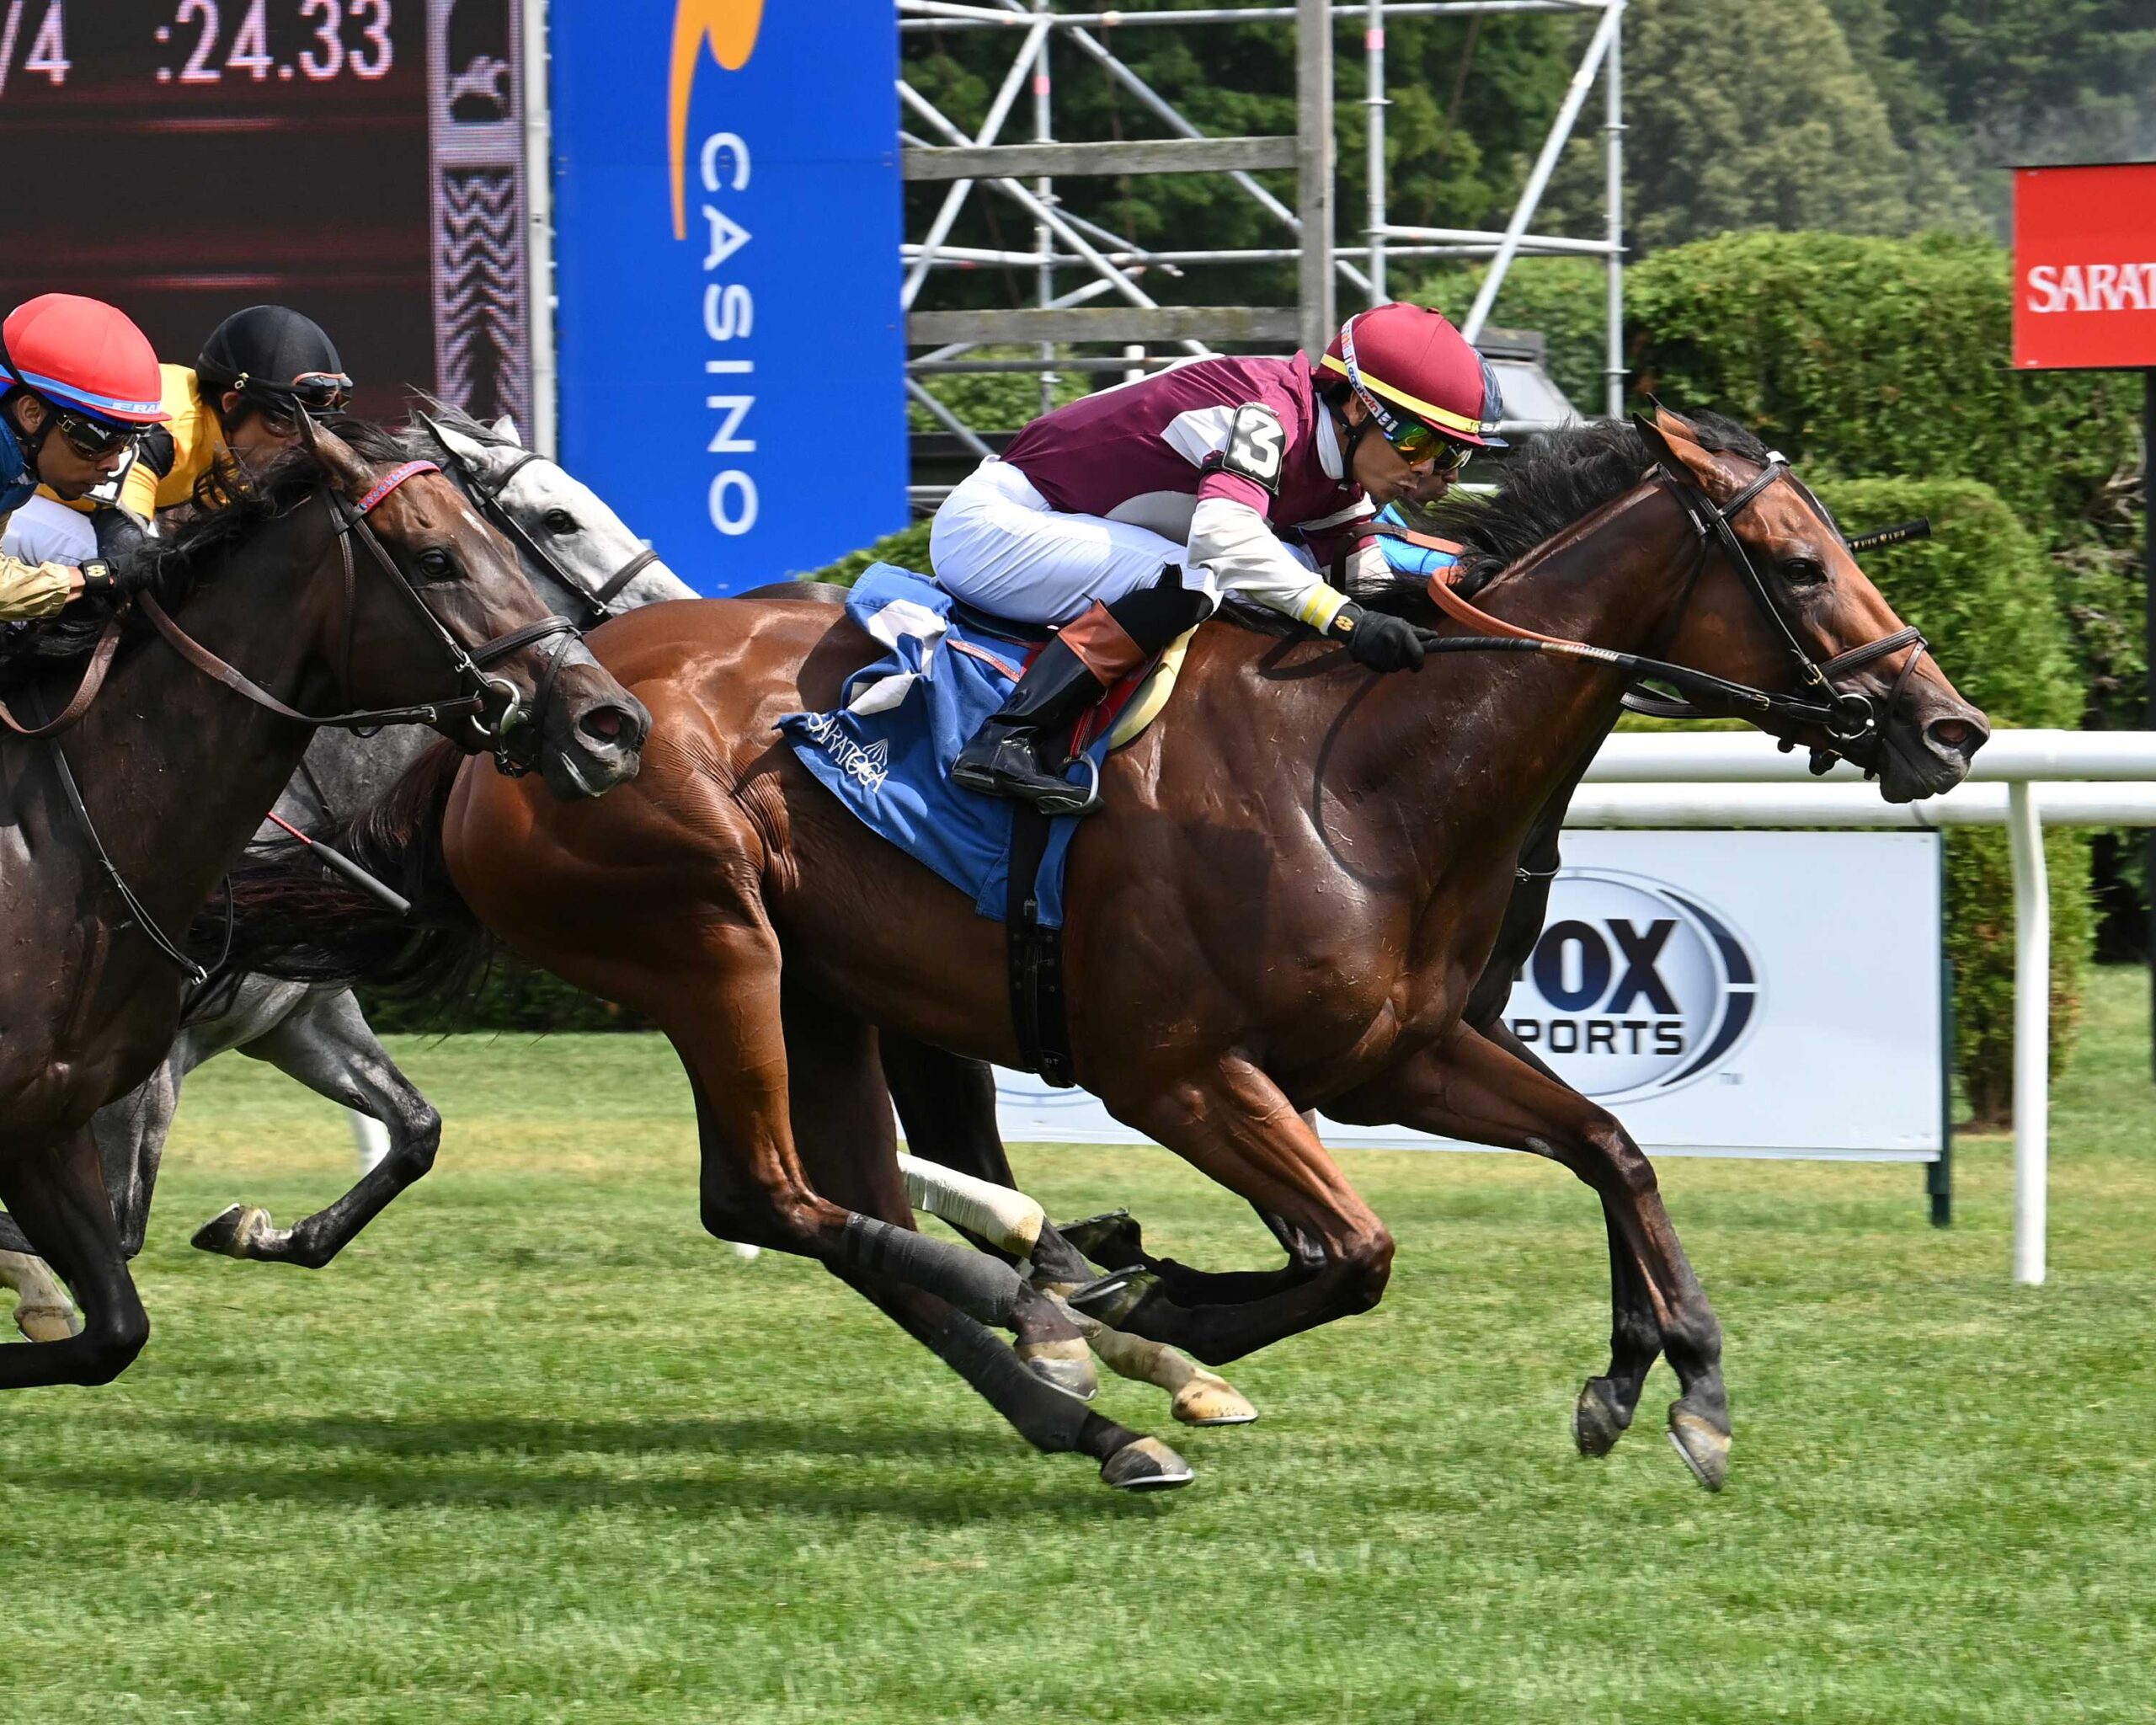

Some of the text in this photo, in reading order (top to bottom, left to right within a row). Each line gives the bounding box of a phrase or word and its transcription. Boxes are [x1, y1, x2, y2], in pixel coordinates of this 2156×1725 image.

[155, 0, 393, 83] :24.33
[701, 132, 759, 537] CASINO
[1231, 408, 1284, 478] 3
[807, 713, 889, 793] SARATOGA
[1513, 918, 1684, 1015] OX
[1512, 1018, 1684, 1055] PORTS
